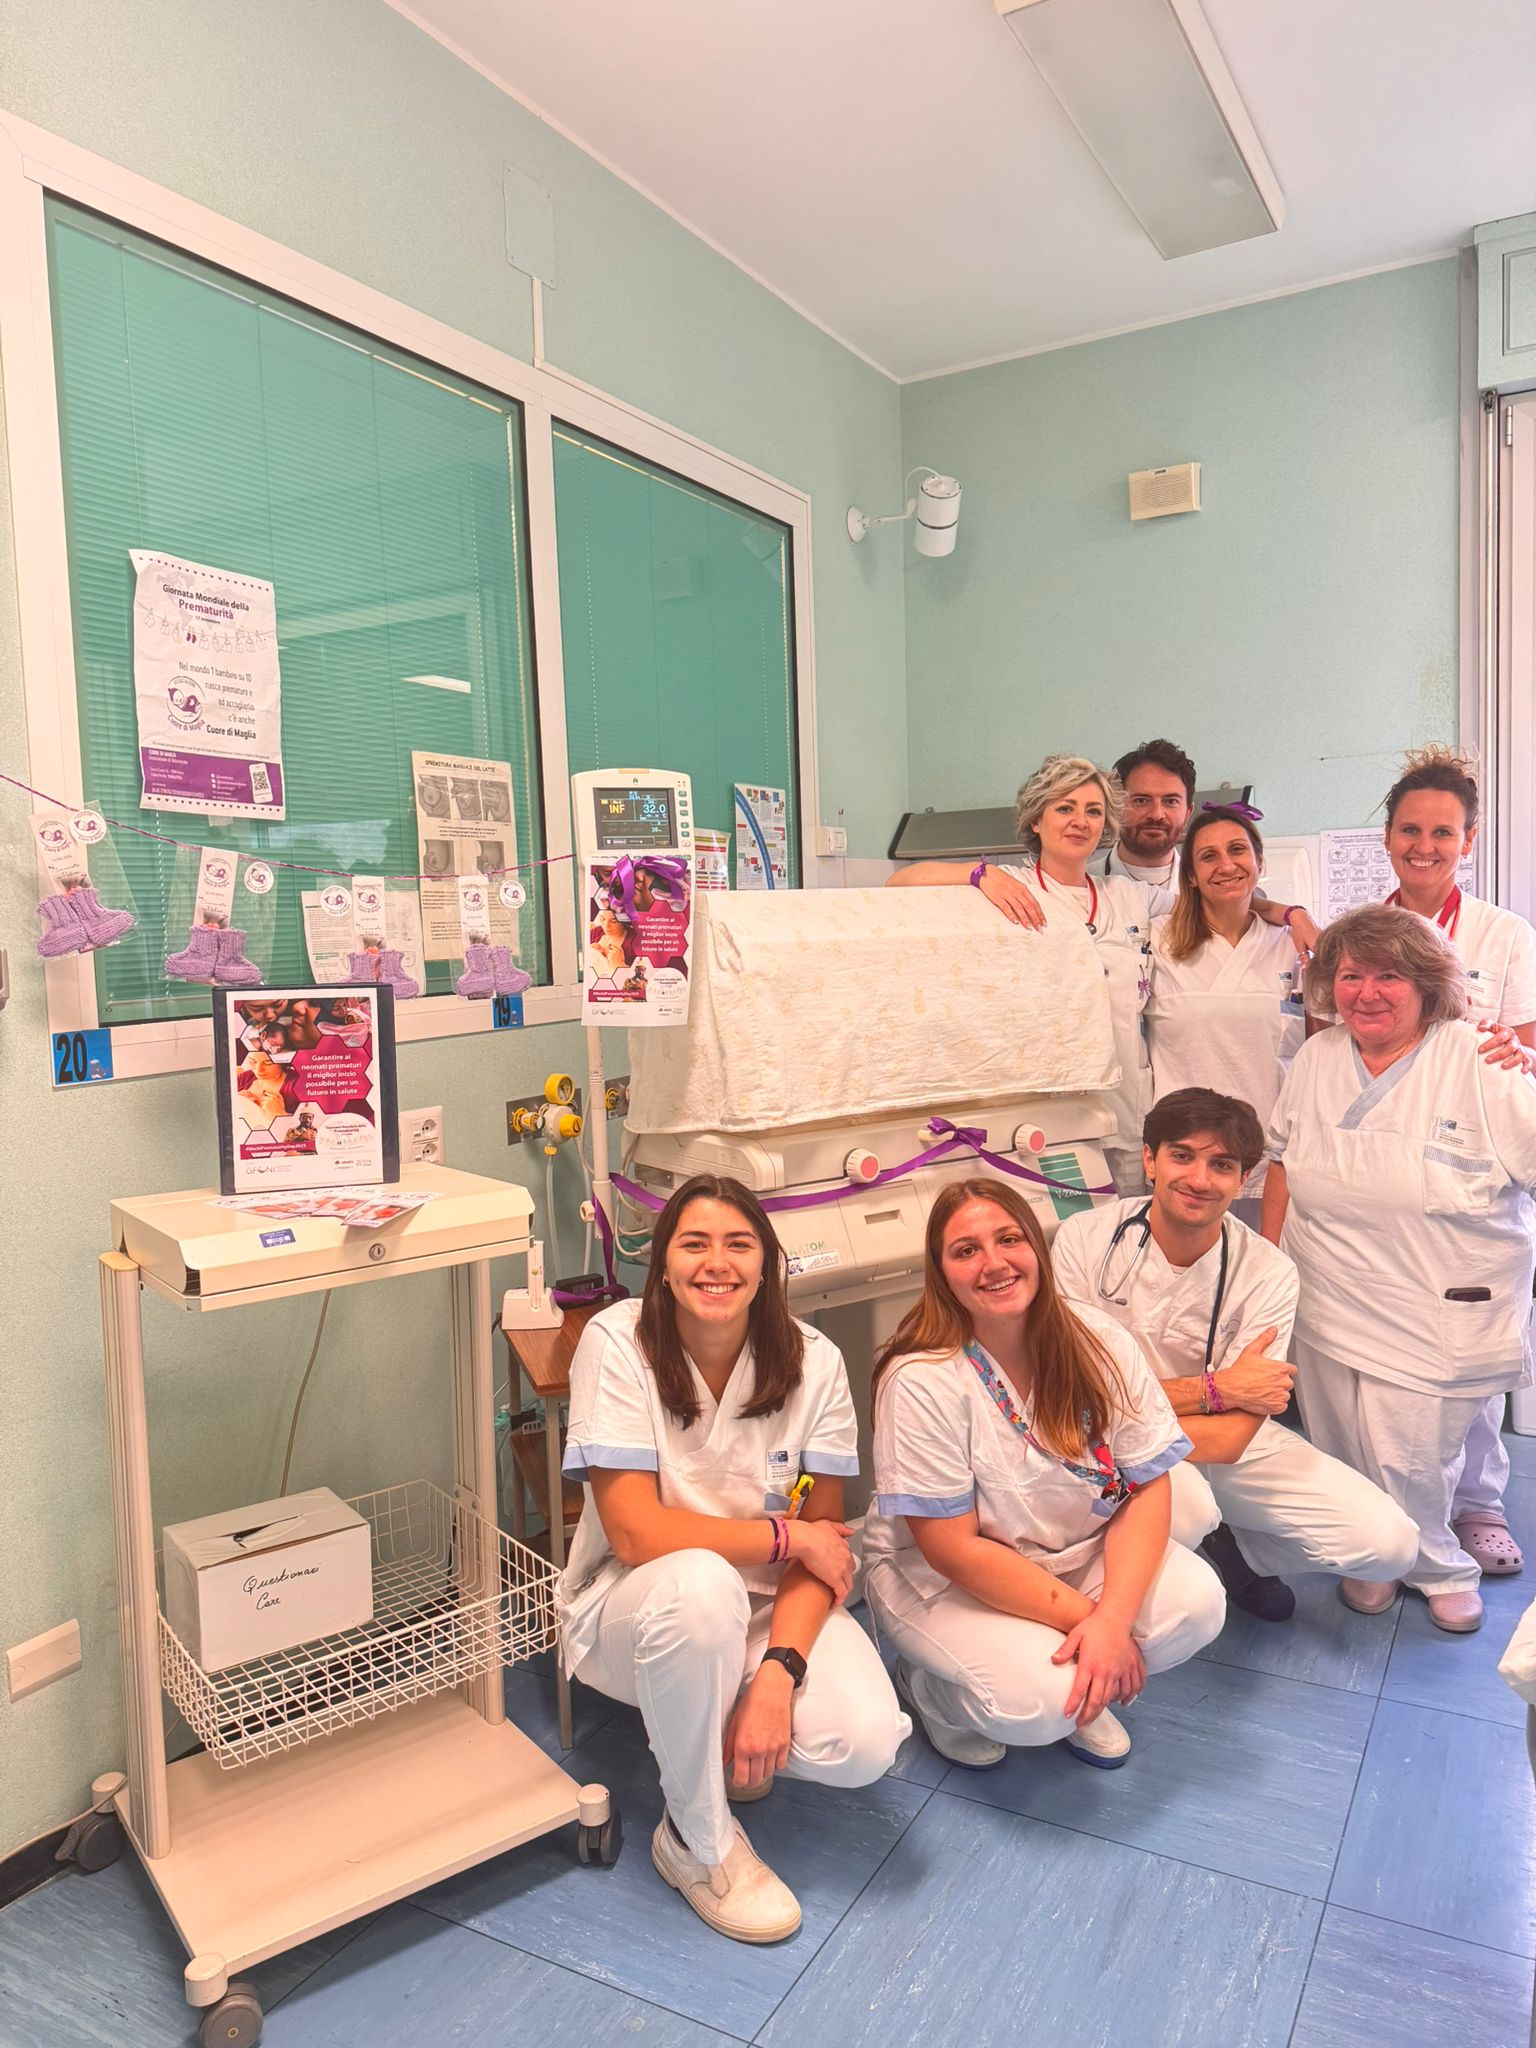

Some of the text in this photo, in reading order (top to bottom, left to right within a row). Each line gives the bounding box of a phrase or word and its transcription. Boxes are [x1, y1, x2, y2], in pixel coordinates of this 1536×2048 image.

[162, 584, 249, 612] Giornata Mondiale della
[178, 598, 234, 620] Prematurità
[179, 661, 189, 671] Nel
[190, 665, 210, 674] mondo
[215, 667, 238, 680] bambino
[205, 682, 221, 691] nasce
[238, 716, 256, 725] anche
[206, 724, 257, 740] Cuore di Maglia
[609, 804, 625, 814] INF
[643, 804, 666, 814] 32.0
[56, 1032, 88, 1084] 20
[301, 1062, 362, 1071] neonati prematuri
[312, 1071, 337, 1080] miglior
[305, 1080, 336, 1088] possibile
[336, 1080, 348, 1088] per
